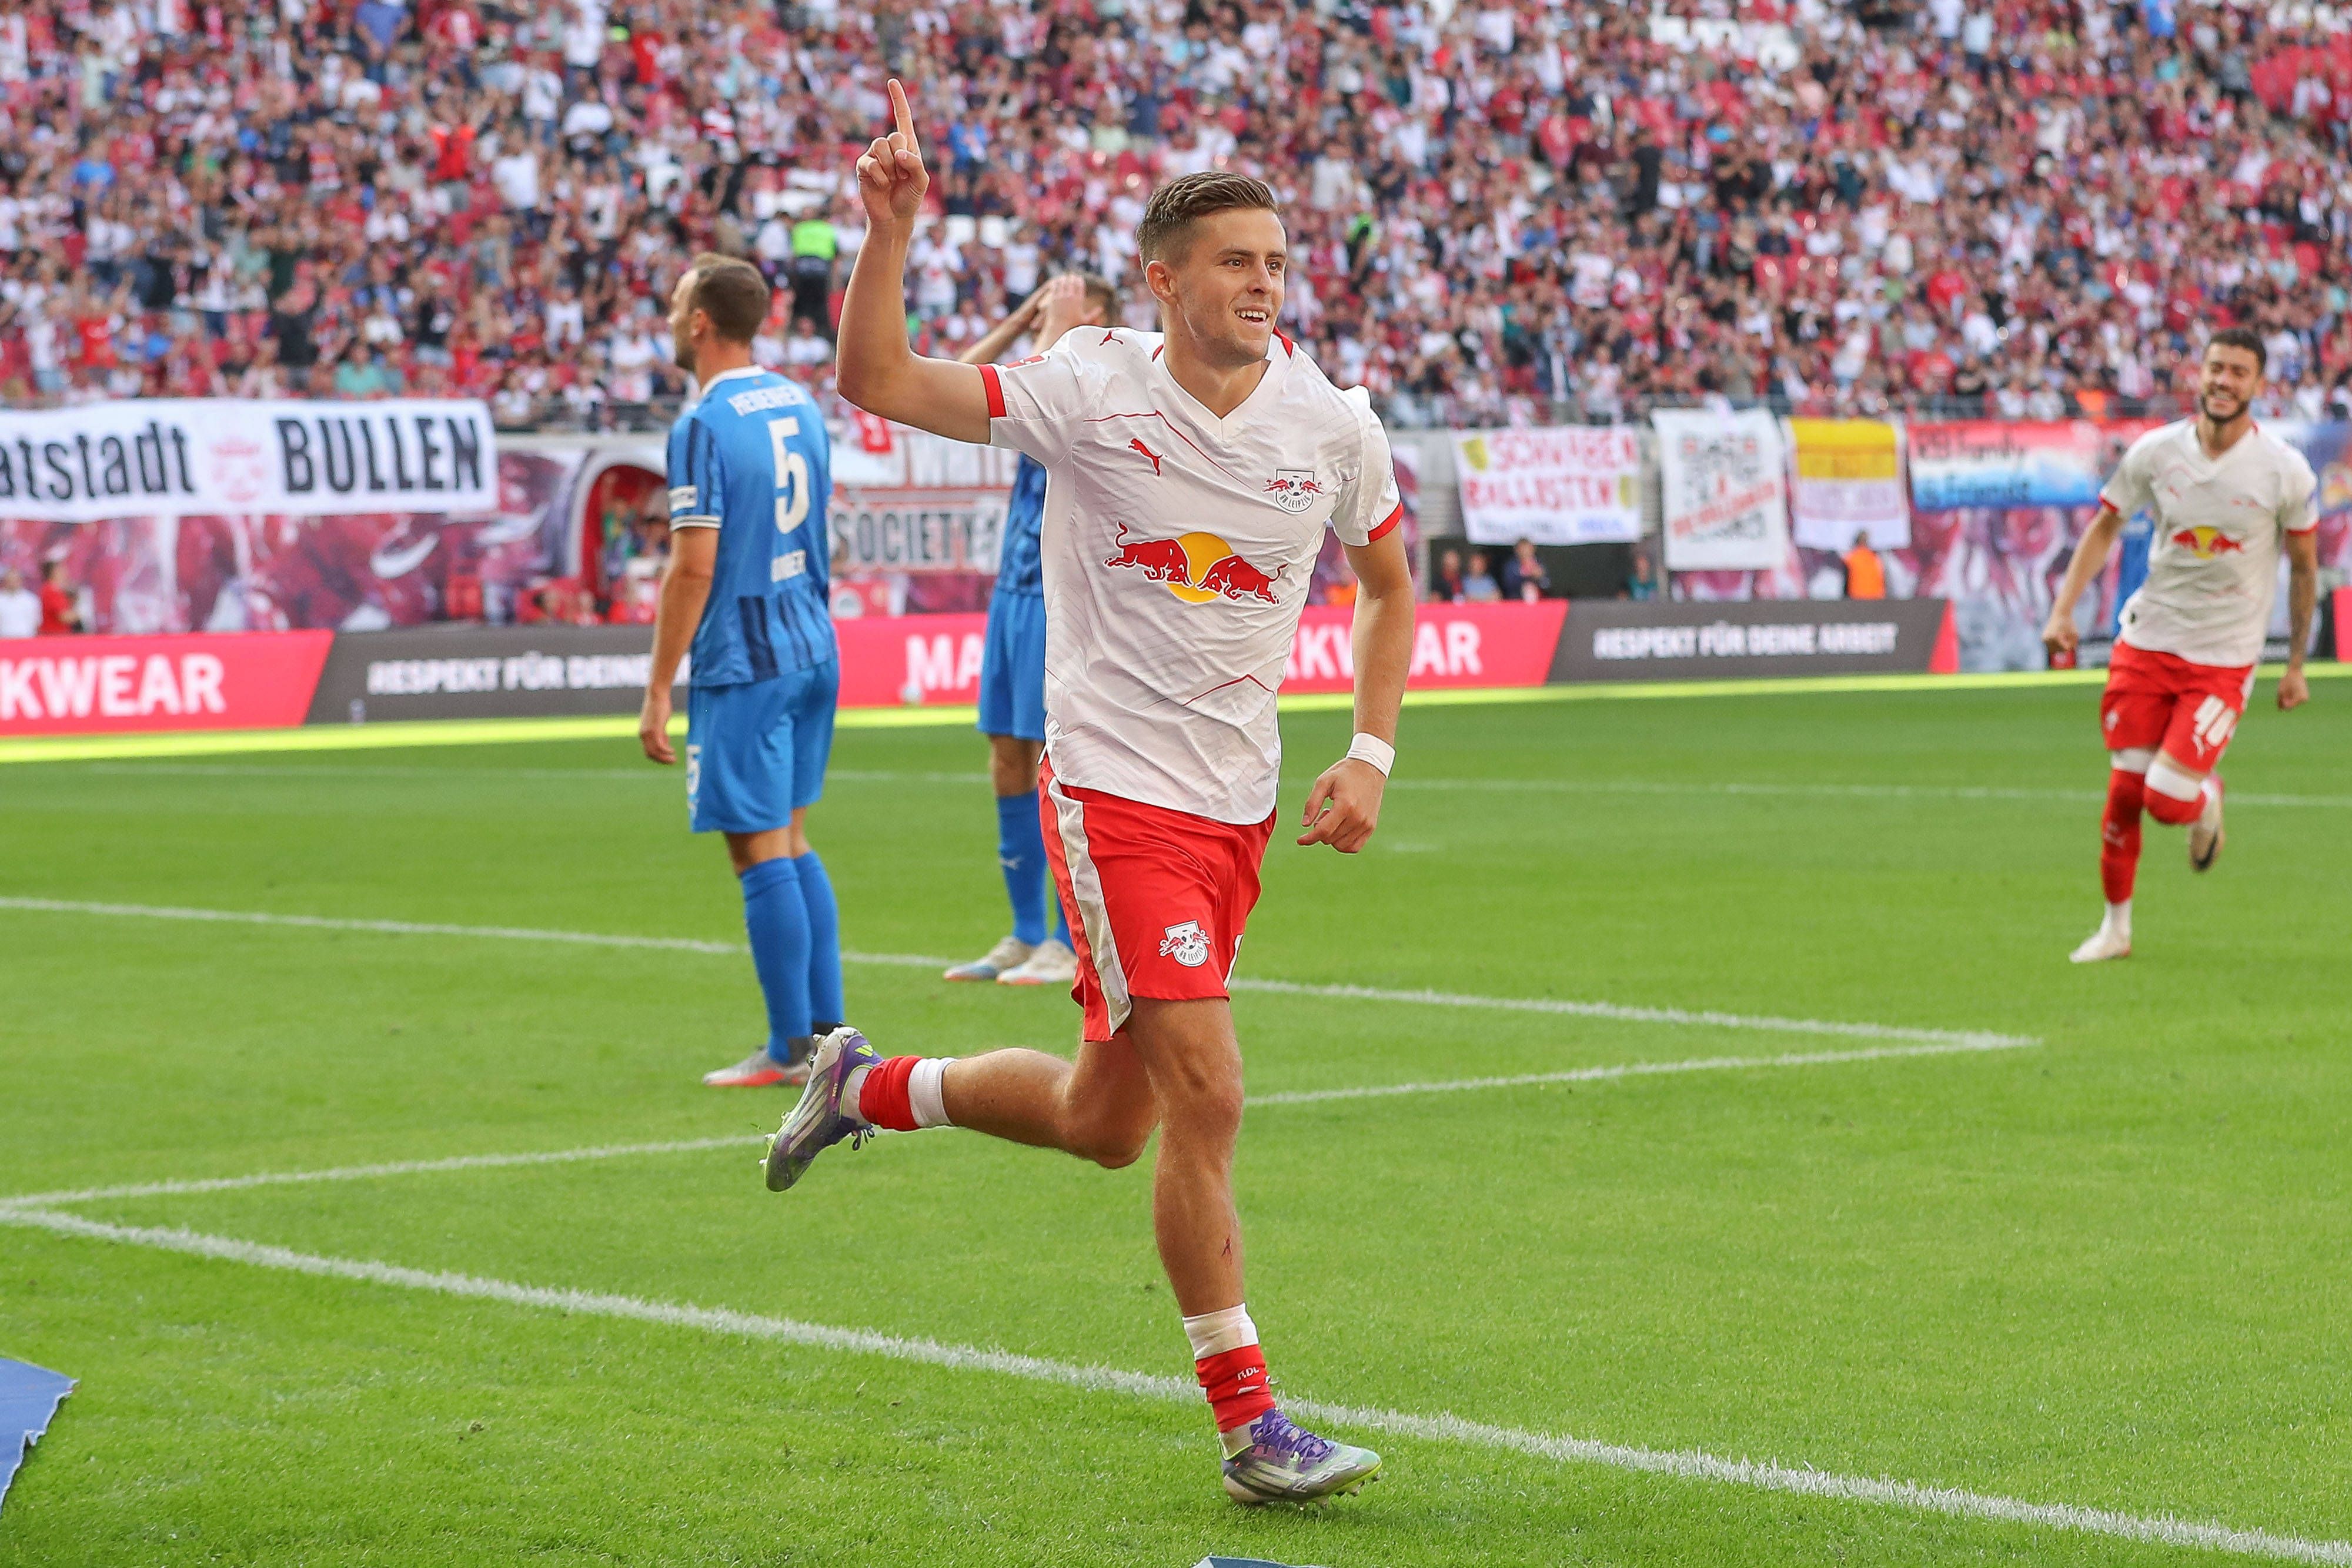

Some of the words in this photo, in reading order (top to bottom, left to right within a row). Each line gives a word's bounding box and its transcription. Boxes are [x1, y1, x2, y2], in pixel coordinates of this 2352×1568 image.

[276, 417, 483, 494] BULLEN
[767, 416, 810, 534] 5
[1288, 495, 1311, 508] LEIPZIG
[833, 511, 975, 562] SOCIETY
[1592, 627, 1698, 660] RESPEKT
[1698, 620, 1746, 657] FÜR
[1746, 623, 1817, 656] DEINE
[1819, 622, 1899, 654] ARBEIT
[367, 658, 502, 695] RESPEKT
[503, 650, 565, 691] FÜR
[2194, 694, 2237, 747] 10
